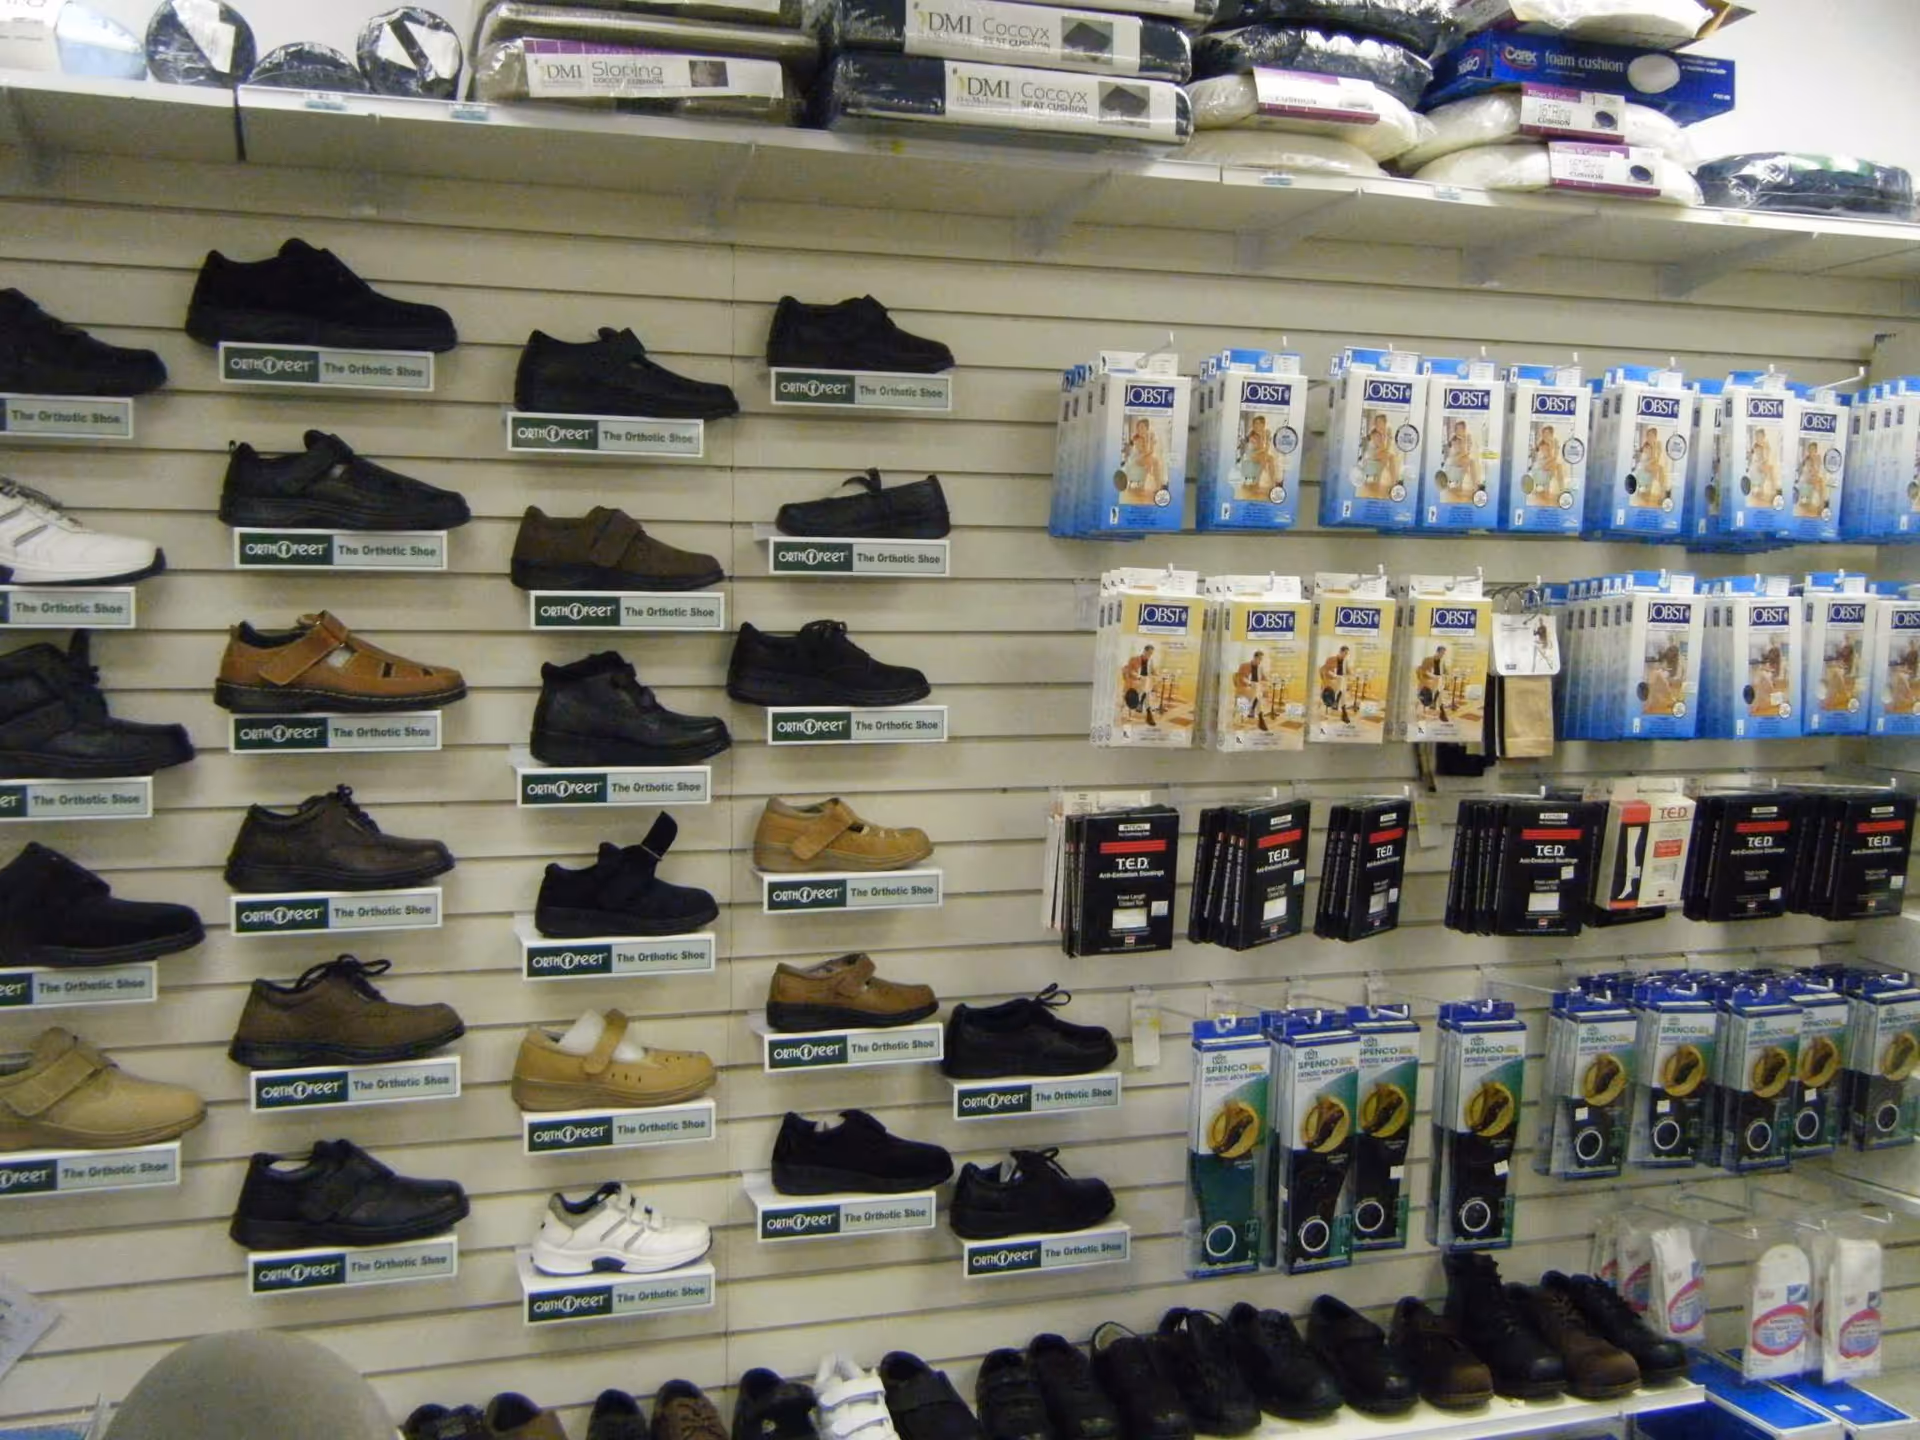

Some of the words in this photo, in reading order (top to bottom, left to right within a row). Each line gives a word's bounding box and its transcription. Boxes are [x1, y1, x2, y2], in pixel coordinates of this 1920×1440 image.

[929, 12, 971, 34] DMI
[1545, 50, 1575, 67] foam
[1578, 57, 1624, 73] cushion
[547, 64, 582, 79] DMI
[968, 77, 1010, 99] DMI
[1021, 82, 1088, 109] Coccyx
[1047, 103, 1088, 114] CUSHION
[325, 362, 344, 373] The
[349, 363, 392, 375] Orthotic
[396, 366, 424, 377] Shoe
[860, 385, 877, 395] The
[880, 386, 917, 397] Orthotic
[921, 387, 943, 398] Shoe
[1126, 383, 1170, 404] JOBST
[1242, 382, 1286, 402] JOBST
[1365, 379, 1407, 400] JOBST
[1444, 389, 1486, 408] JOBST
[1532, 394, 1571, 413] JOBST
[1637, 396, 1675, 414] JOBST
[1747, 398, 1780, 417] JOBST
[11, 410, 34, 421] The
[38, 410, 88, 423] Orthotic
[92, 412, 121, 424] Shoe
[1801, 412, 1831, 430] JOBST
[603, 431, 622, 441] The
[625, 432, 665, 443] Orthotic
[670, 433, 695, 444] Shoe
[338, 545, 358, 555] The
[363, 545, 406, 556] Orthotic
[410, 546, 436, 557] Shoe
[857, 552, 875, 563] The
[878, 553, 915, 564] Orthotic
[918, 553, 941, 564] Shoe
[15, 602, 37, 613] The
[41, 602, 90, 614] Orthotic
[94, 602, 123, 614] Shoe
[625, 606, 643, 617] The
[647, 606, 687, 617] Orthotic
[691, 606, 715, 617] Shoe
[1139, 604, 1180, 623] JOBST
[1336, 607, 1376, 625] JOBST
[1649, 604, 1687, 621] JOBST
[1750, 607, 1785, 624] JOBST
[1828, 603, 1862, 621] JOBST
[1247, 611, 1288, 629] JOBST
[1432, 608, 1471, 626] JOBST
[1892, 611, 1920, 628] JOBS
[333, 728, 354, 738] The
[357, 727, 401, 738] Orthotic
[405, 725, 431, 737] Shoe
[855, 720, 873, 731] The
[876, 719, 913, 731] Orthotic
[917, 719, 939, 730] Shoe
[612, 783, 630, 793] The
[634, 781, 673, 792] Orthotic
[678, 780, 702, 791] Shoe
[32, 795, 54, 806] The
[59, 793, 108, 805] Orthotic
[112, 794, 141, 804] Shoe
[852, 887, 868, 897] The
[872, 885, 908, 896] Orthotic
[912, 884, 934, 895] Shoe
[334, 907, 354, 918] The
[358, 906, 400, 917] Orthotic
[405, 904, 431, 915] Shoe
[617, 953, 635, 963] The
[638, 951, 677, 962] Orthotic
[681, 950, 706, 960] Shoe
[852, 1042, 869, 1053] The
[872, 1040, 909, 1051] Orthotic
[912, 1038, 936, 1049] Shoe
[1464, 1045, 1504, 1055] SPENCO
[1206, 1063, 1249, 1074] SPENCO
[1298, 1058, 1338, 1070] SPENCO
[354, 1079, 373, 1091] The
[378, 1077, 419, 1089] Orthotic
[424, 1074, 449, 1086] Shoe
[1036, 1092, 1051, 1102] The
[1054, 1090, 1089, 1101] Orthotic
[1092, 1087, 1112, 1098] Shoe
[617, 1124, 635, 1135] The
[639, 1121, 678, 1133] Orthotic
[682, 1119, 706, 1130] Shoe
[845, 1212, 861, 1224] The
[864, 1210, 901, 1221] Orthotic
[905, 1207, 927, 1219] Shoe
[1045, 1248, 1060, 1258] The
[1064, 1245, 1098, 1256] Orthotic
[1101, 1242, 1121, 1253] Shoe
[352, 1261, 371, 1272] The
[375, 1258, 417, 1270] Orthotic
[421, 1255, 448, 1267] Shoe
[617, 1292, 635, 1303] The
[638, 1289, 678, 1301] Orthotic
[682, 1286, 706, 1298] Shoe
